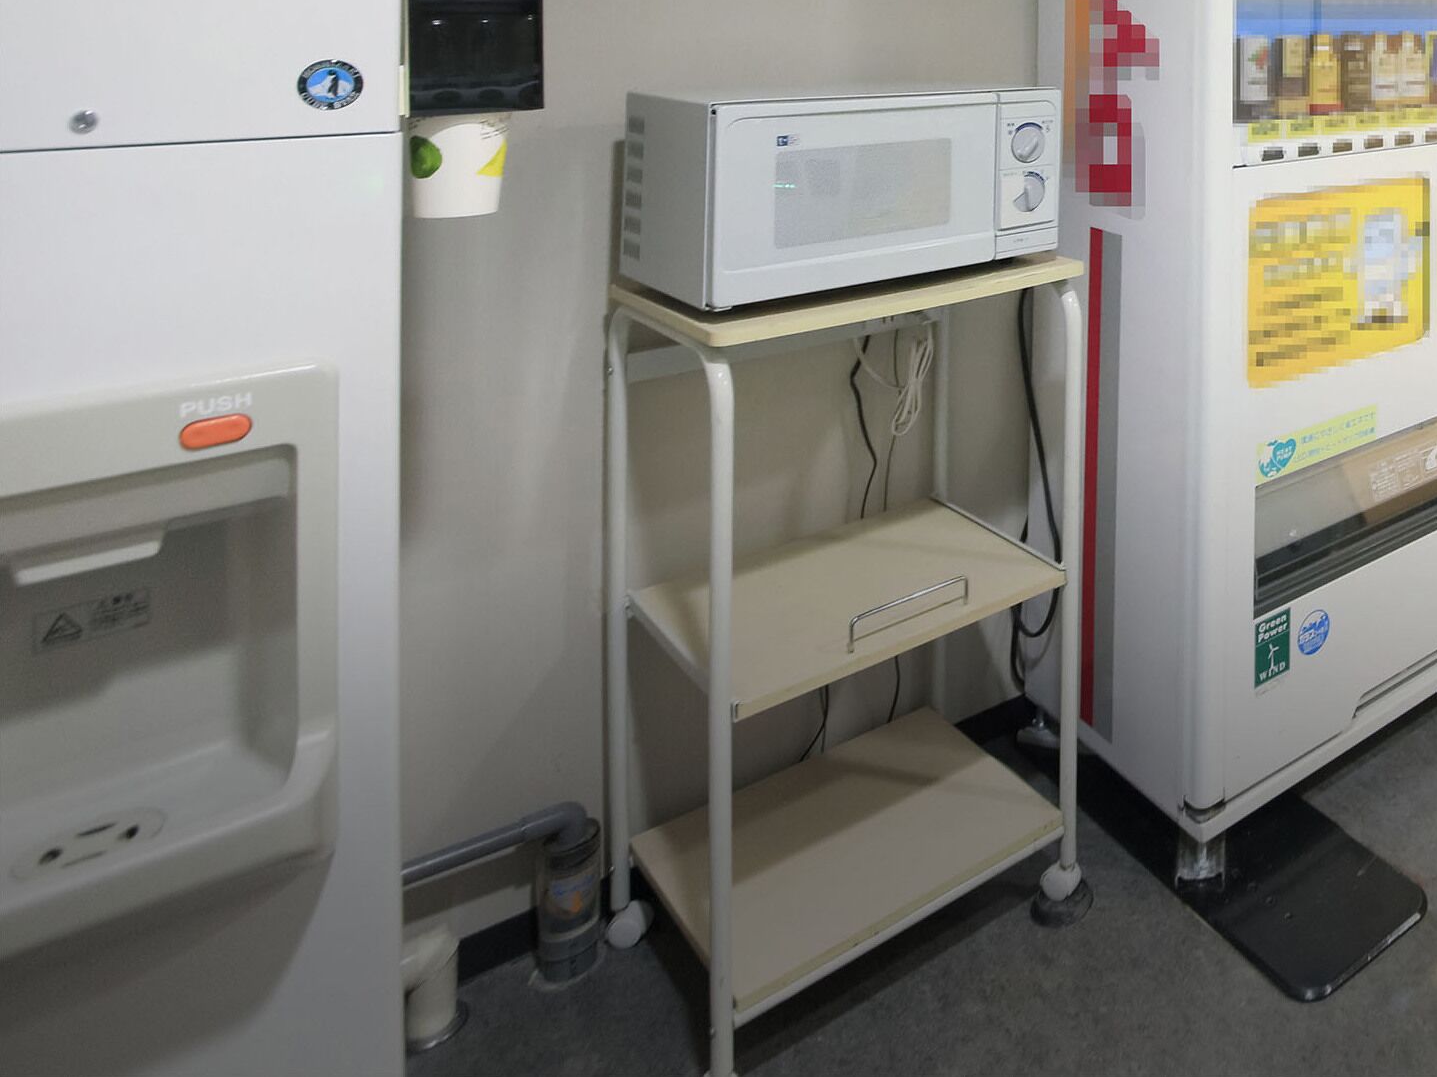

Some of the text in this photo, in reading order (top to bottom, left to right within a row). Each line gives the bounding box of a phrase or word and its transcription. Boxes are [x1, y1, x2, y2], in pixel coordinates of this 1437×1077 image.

[180, 392, 252, 418] PUSH
[1257, 623, 1288, 644] Power
[1258, 614, 1288, 634] Green
[1259, 661, 1286, 681] WIND
